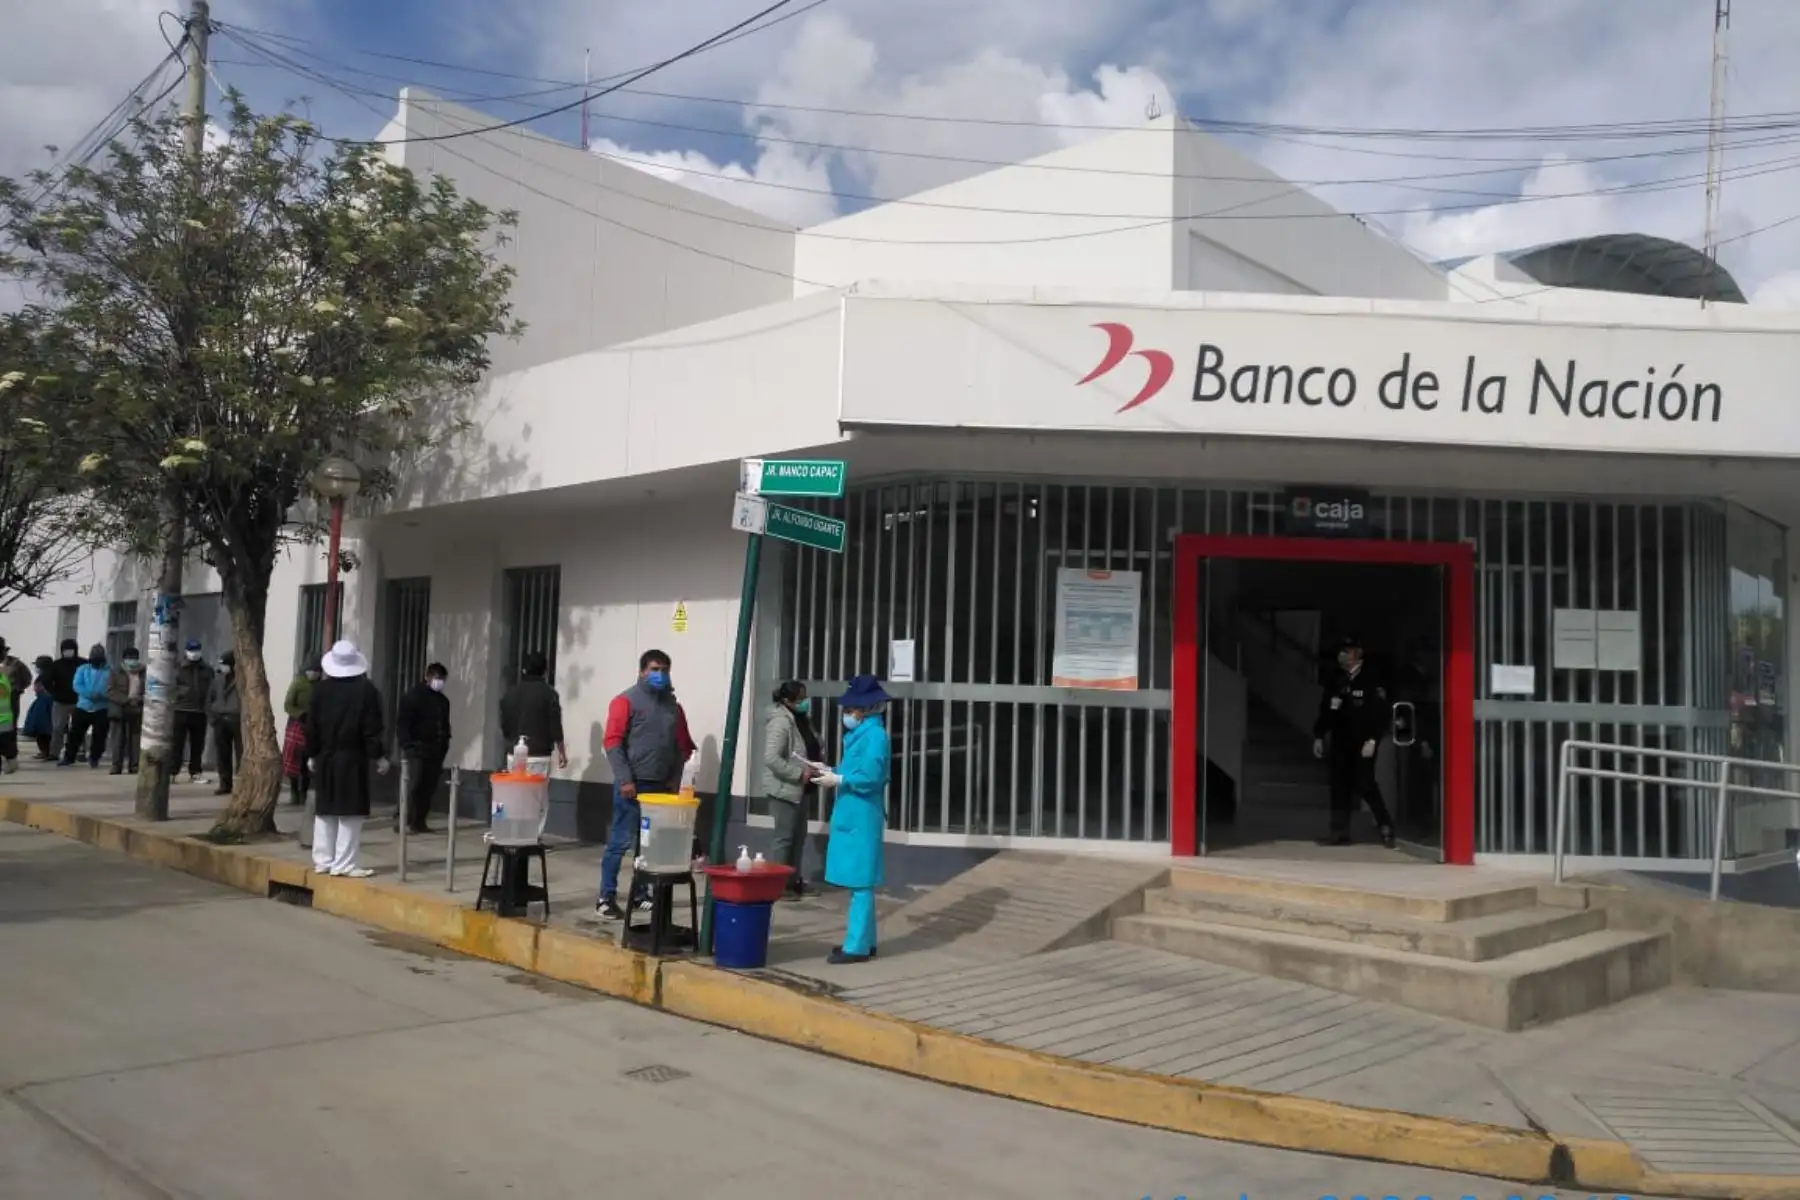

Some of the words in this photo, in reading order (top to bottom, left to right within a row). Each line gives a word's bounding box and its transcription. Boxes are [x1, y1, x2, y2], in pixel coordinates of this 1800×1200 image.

[1192, 344, 1357, 407] Banco
[1379, 352, 1440, 411] de
[1461, 356, 1507, 414] la
[1530, 359, 1722, 422] Nación
[779, 465, 808, 477] MANCO
[810, 466, 838, 478] CAPAC
[1315, 498, 1363, 522] caja
